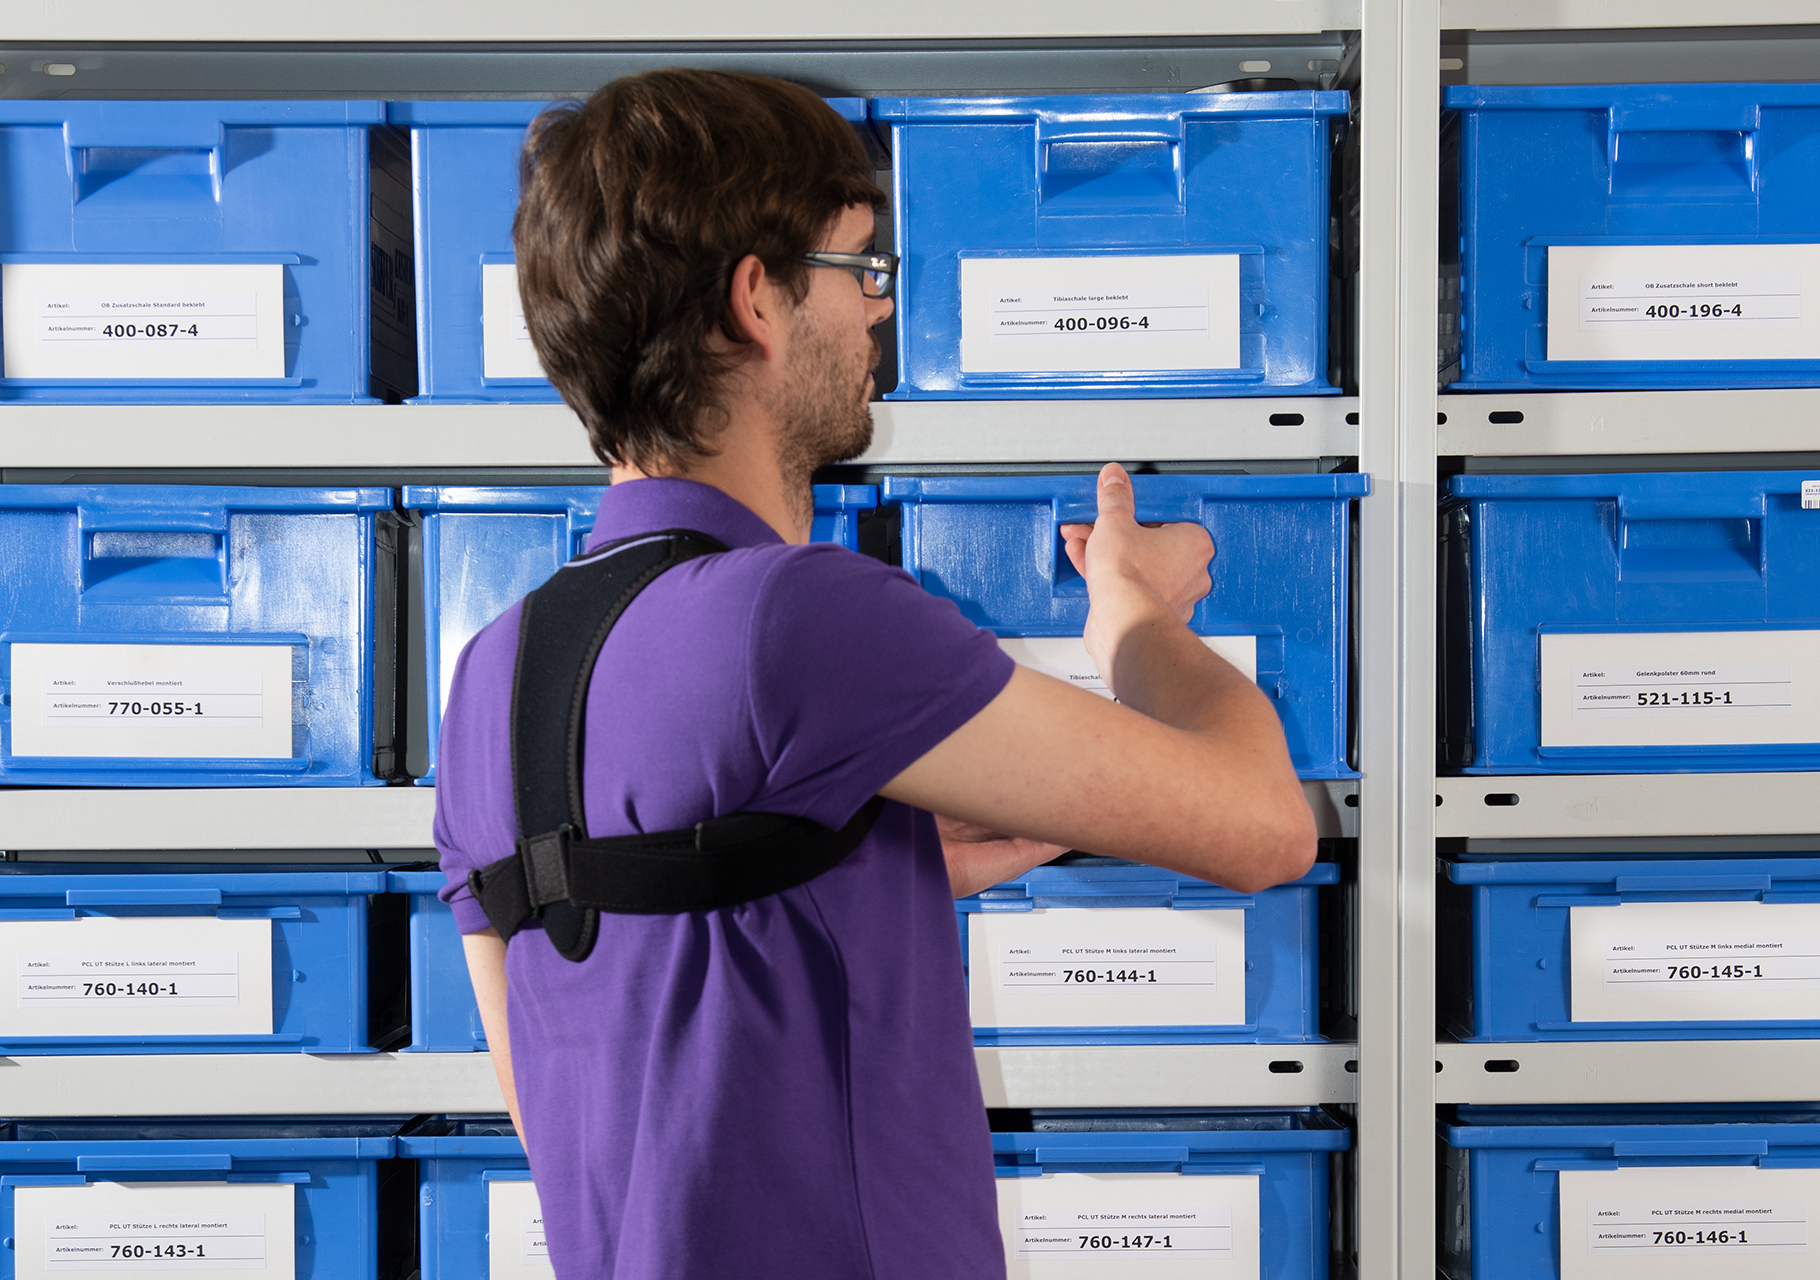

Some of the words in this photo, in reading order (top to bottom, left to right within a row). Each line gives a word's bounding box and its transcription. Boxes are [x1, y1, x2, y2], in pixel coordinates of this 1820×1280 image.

[1088, 295, 1104, 303] large
[1645, 303, 1743, 319] 400-196-4
[102, 323, 199, 338] 400-087-4
[1053, 315, 1150, 331] 400-096-4
[1637, 691, 1733, 706] 521-115-1
[108, 701, 204, 716] 770-055-1
[1063, 969, 1157, 984] 760-144-1
[1667, 964, 1763, 980] 760-145-1
[81, 982, 179, 998] 760-140-1
[1078, 1235, 1173, 1249] 760-147-1
[1652, 1230, 1748, 1246] 760-146-1
[110, 1244, 206, 1259] 760-143-1
